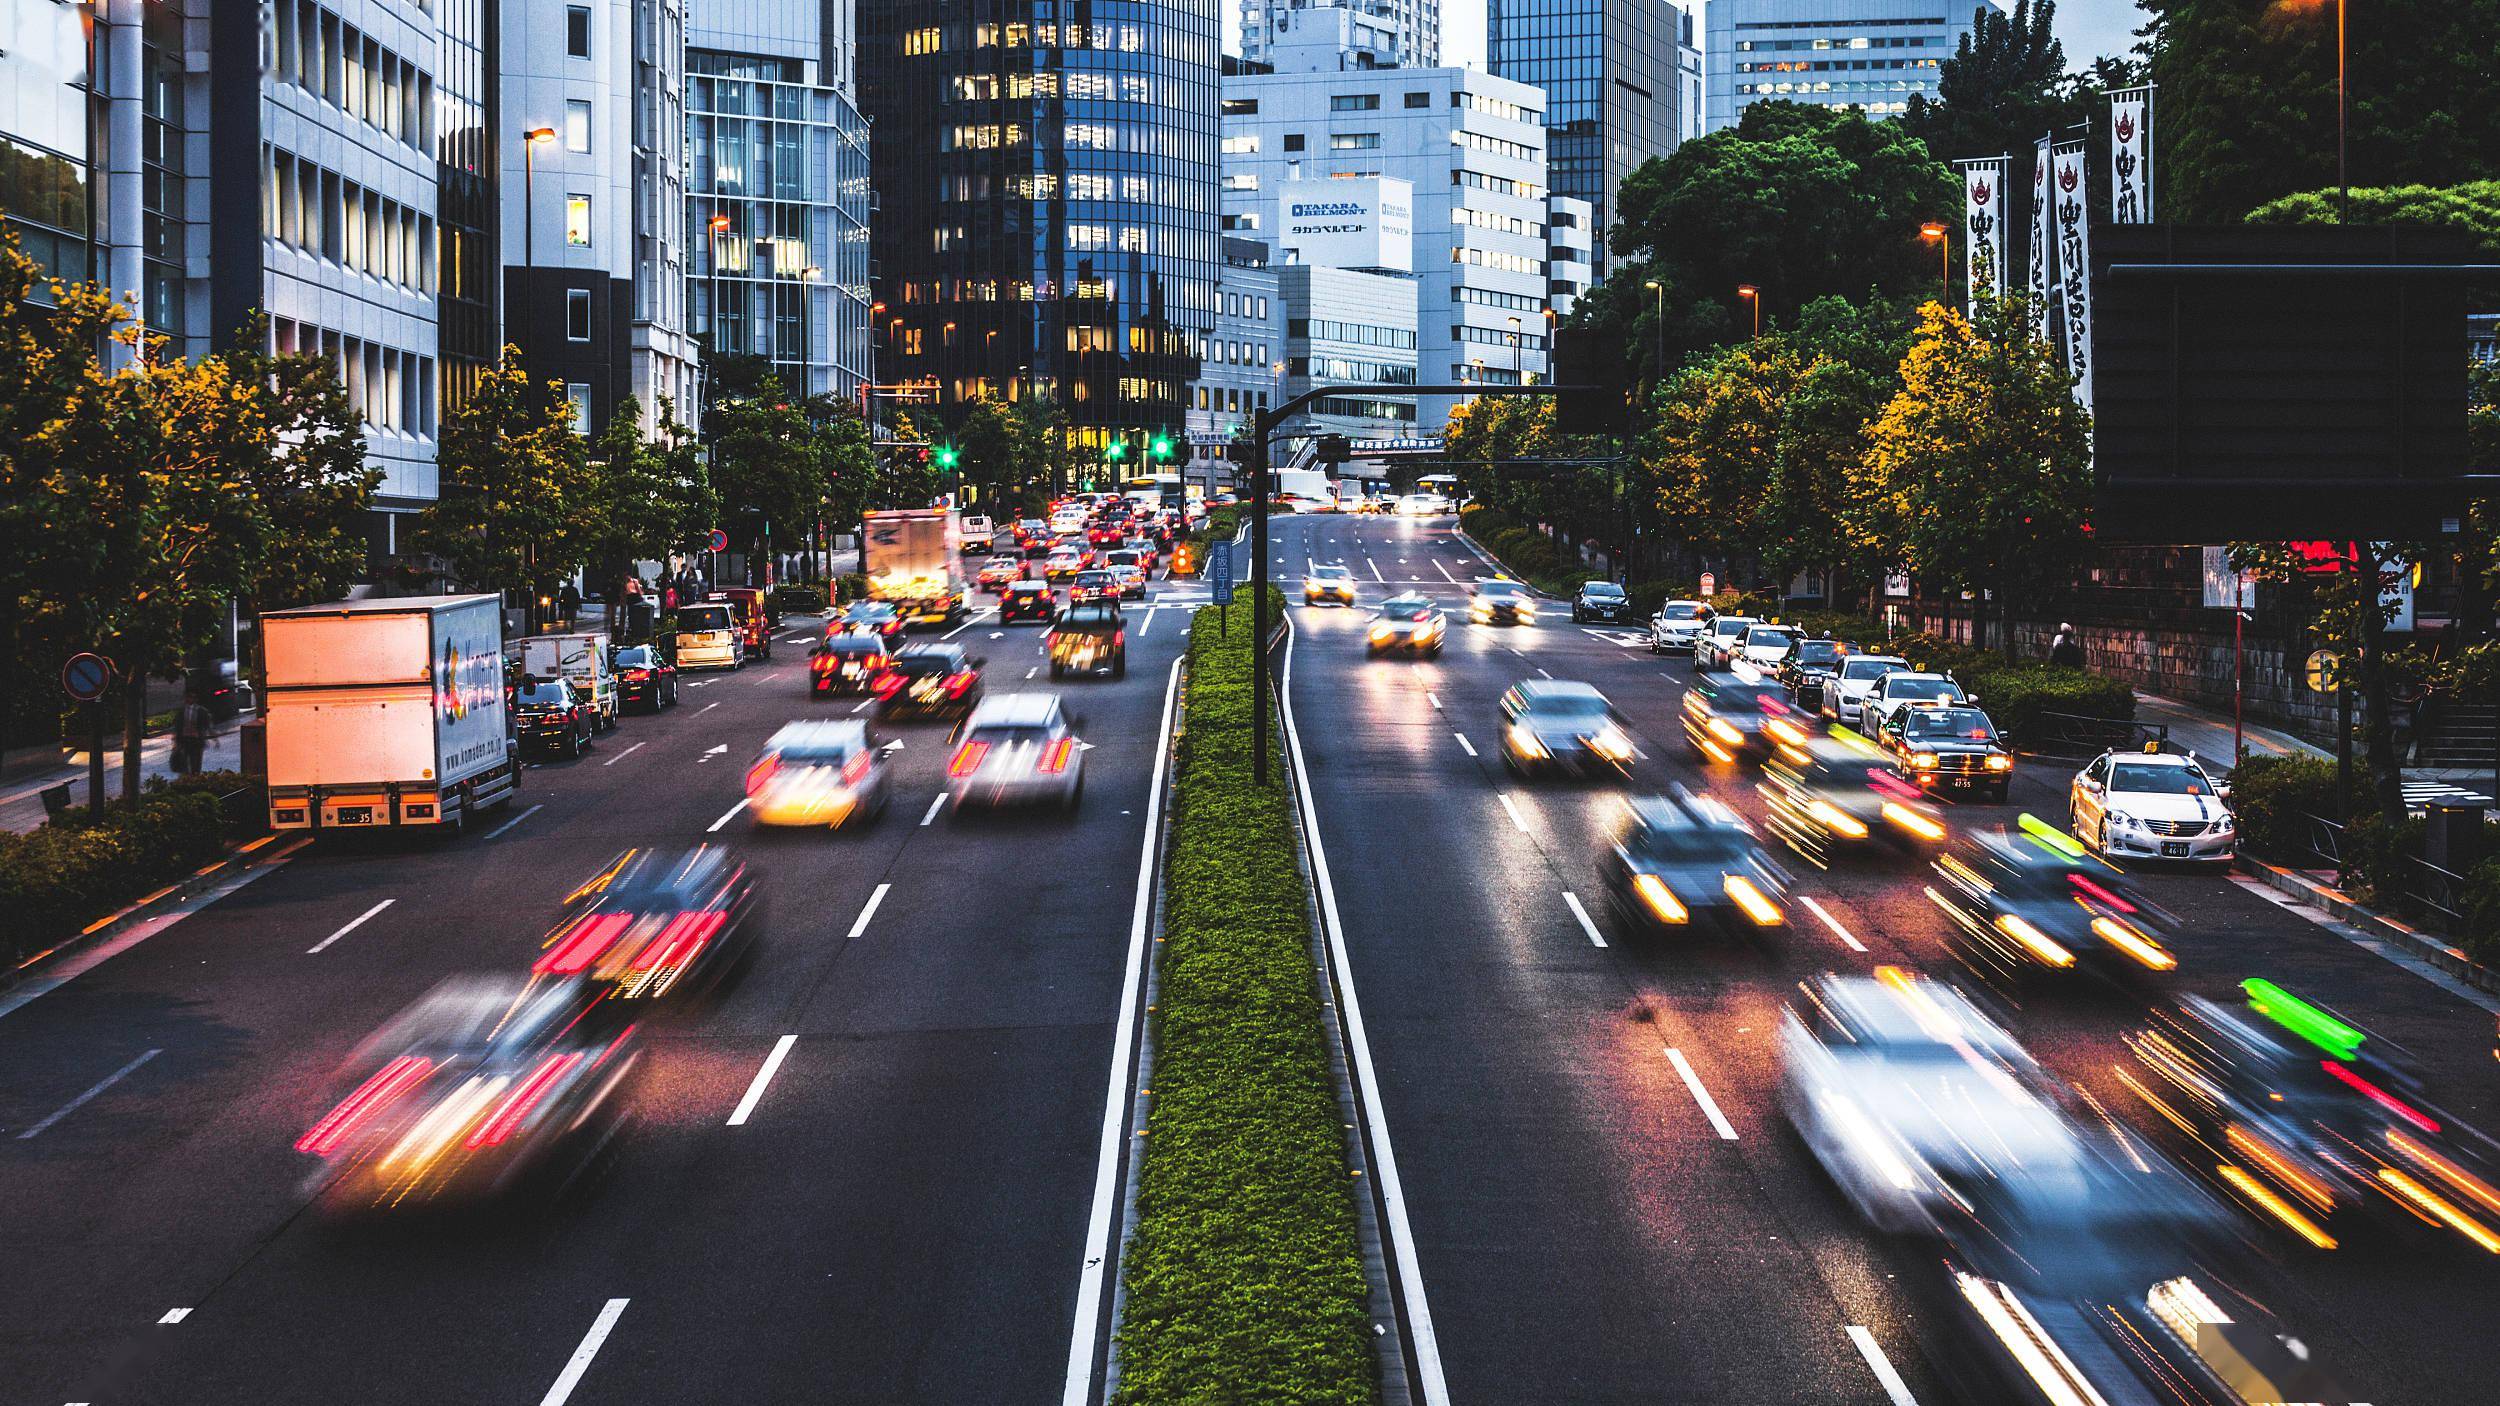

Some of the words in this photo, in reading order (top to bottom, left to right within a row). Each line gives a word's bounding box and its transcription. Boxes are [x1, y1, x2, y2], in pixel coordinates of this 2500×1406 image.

[1303, 208, 1367, 216] BELMONT
[1291, 224, 1367, 234] タカラベルモント
[1217, 545, 1227, 599] 赤坂四丁目
